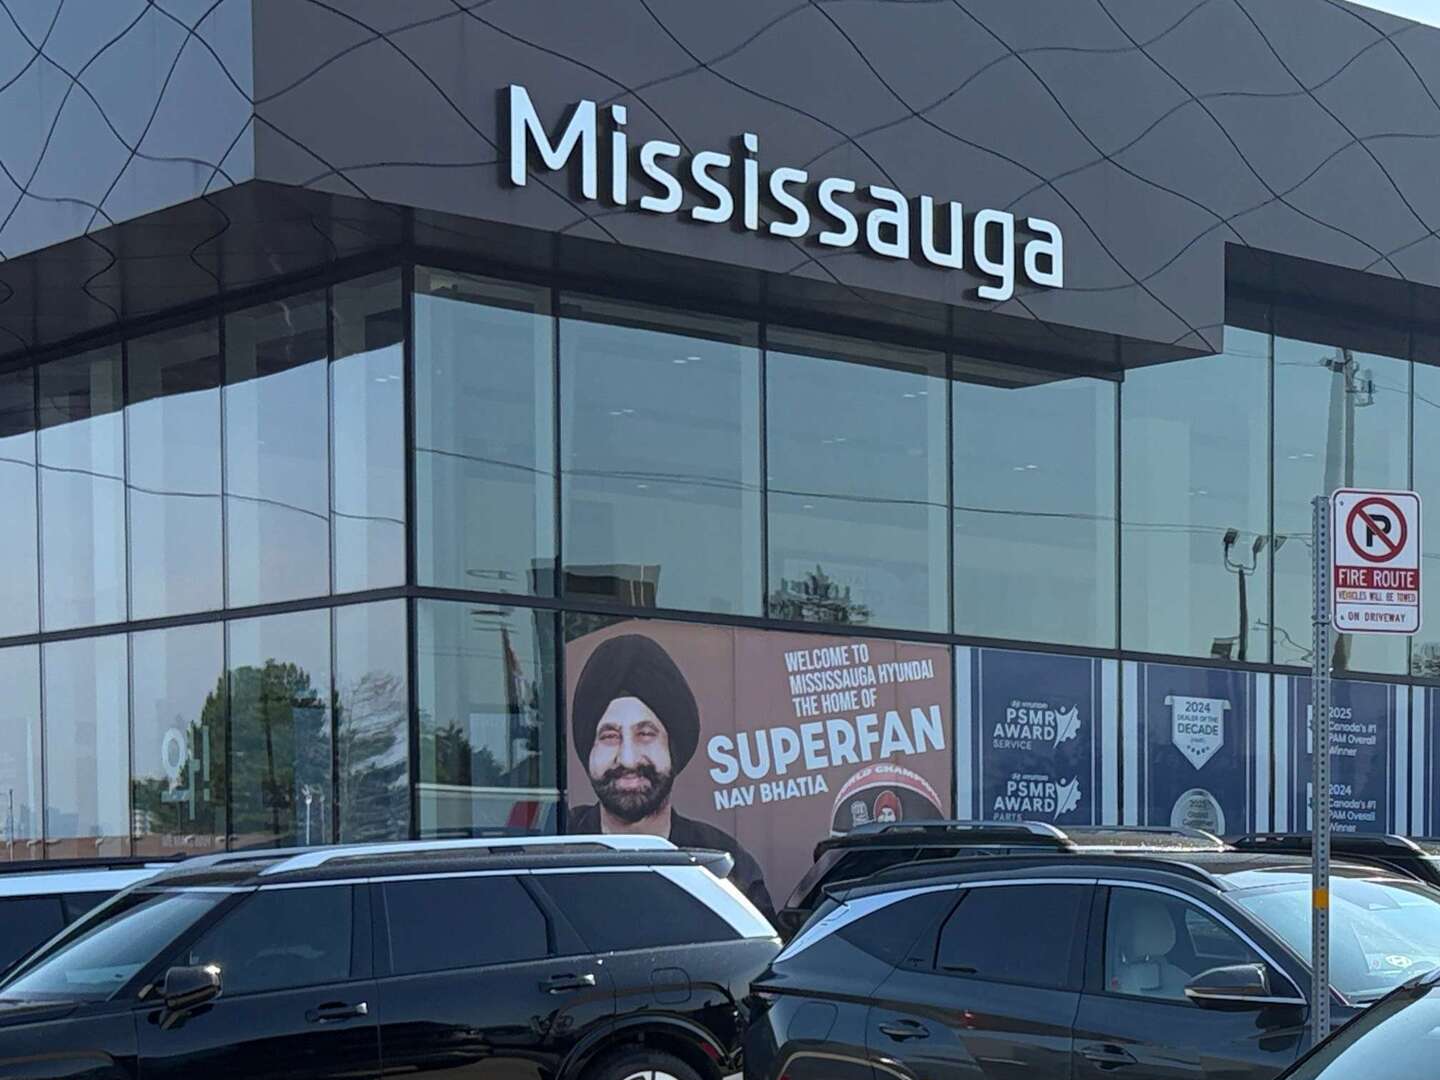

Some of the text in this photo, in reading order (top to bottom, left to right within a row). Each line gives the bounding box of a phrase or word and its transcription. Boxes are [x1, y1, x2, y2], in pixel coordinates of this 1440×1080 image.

[509, 84, 1064, 301] Mississauga
[1338, 568, 1416, 589] FIRE ROUTE
[1338, 590, 1417, 603] VEHICLES WILL BE TOWED
[1347, 611, 1406, 623] ON DRIVEWAY
[785, 643, 870, 673] WELCOME TO
[789, 659, 935, 695] MISSISSAUGA HYUNDAI
[792, 688, 878, 718] THE HOME OF
[1185, 701, 1211, 713] 2024
[1006, 708, 1056, 726] PSMR
[1328, 706, 1352, 719] 2025
[993, 723, 1055, 741] AWARD
[1177, 723, 1219, 736] DECADE
[1328, 721, 1367, 733] Canada's
[707, 705, 945, 784] SUPERFAN
[993, 739, 1032, 750] SERVICE
[1328, 733, 1376, 745] PAM Overall
[1328, 745, 1357, 756] Winner
[714, 774, 829, 810] NAV BHATIA
[1007, 780, 1056, 798] PSMR
[1328, 784, 1352, 796] 2024
[993, 796, 1055, 812] AWARD
[1328, 798, 1366, 810] Canada's
[993, 812, 1022, 822] PARTS
[1328, 809, 1376, 821] PAM Overall
